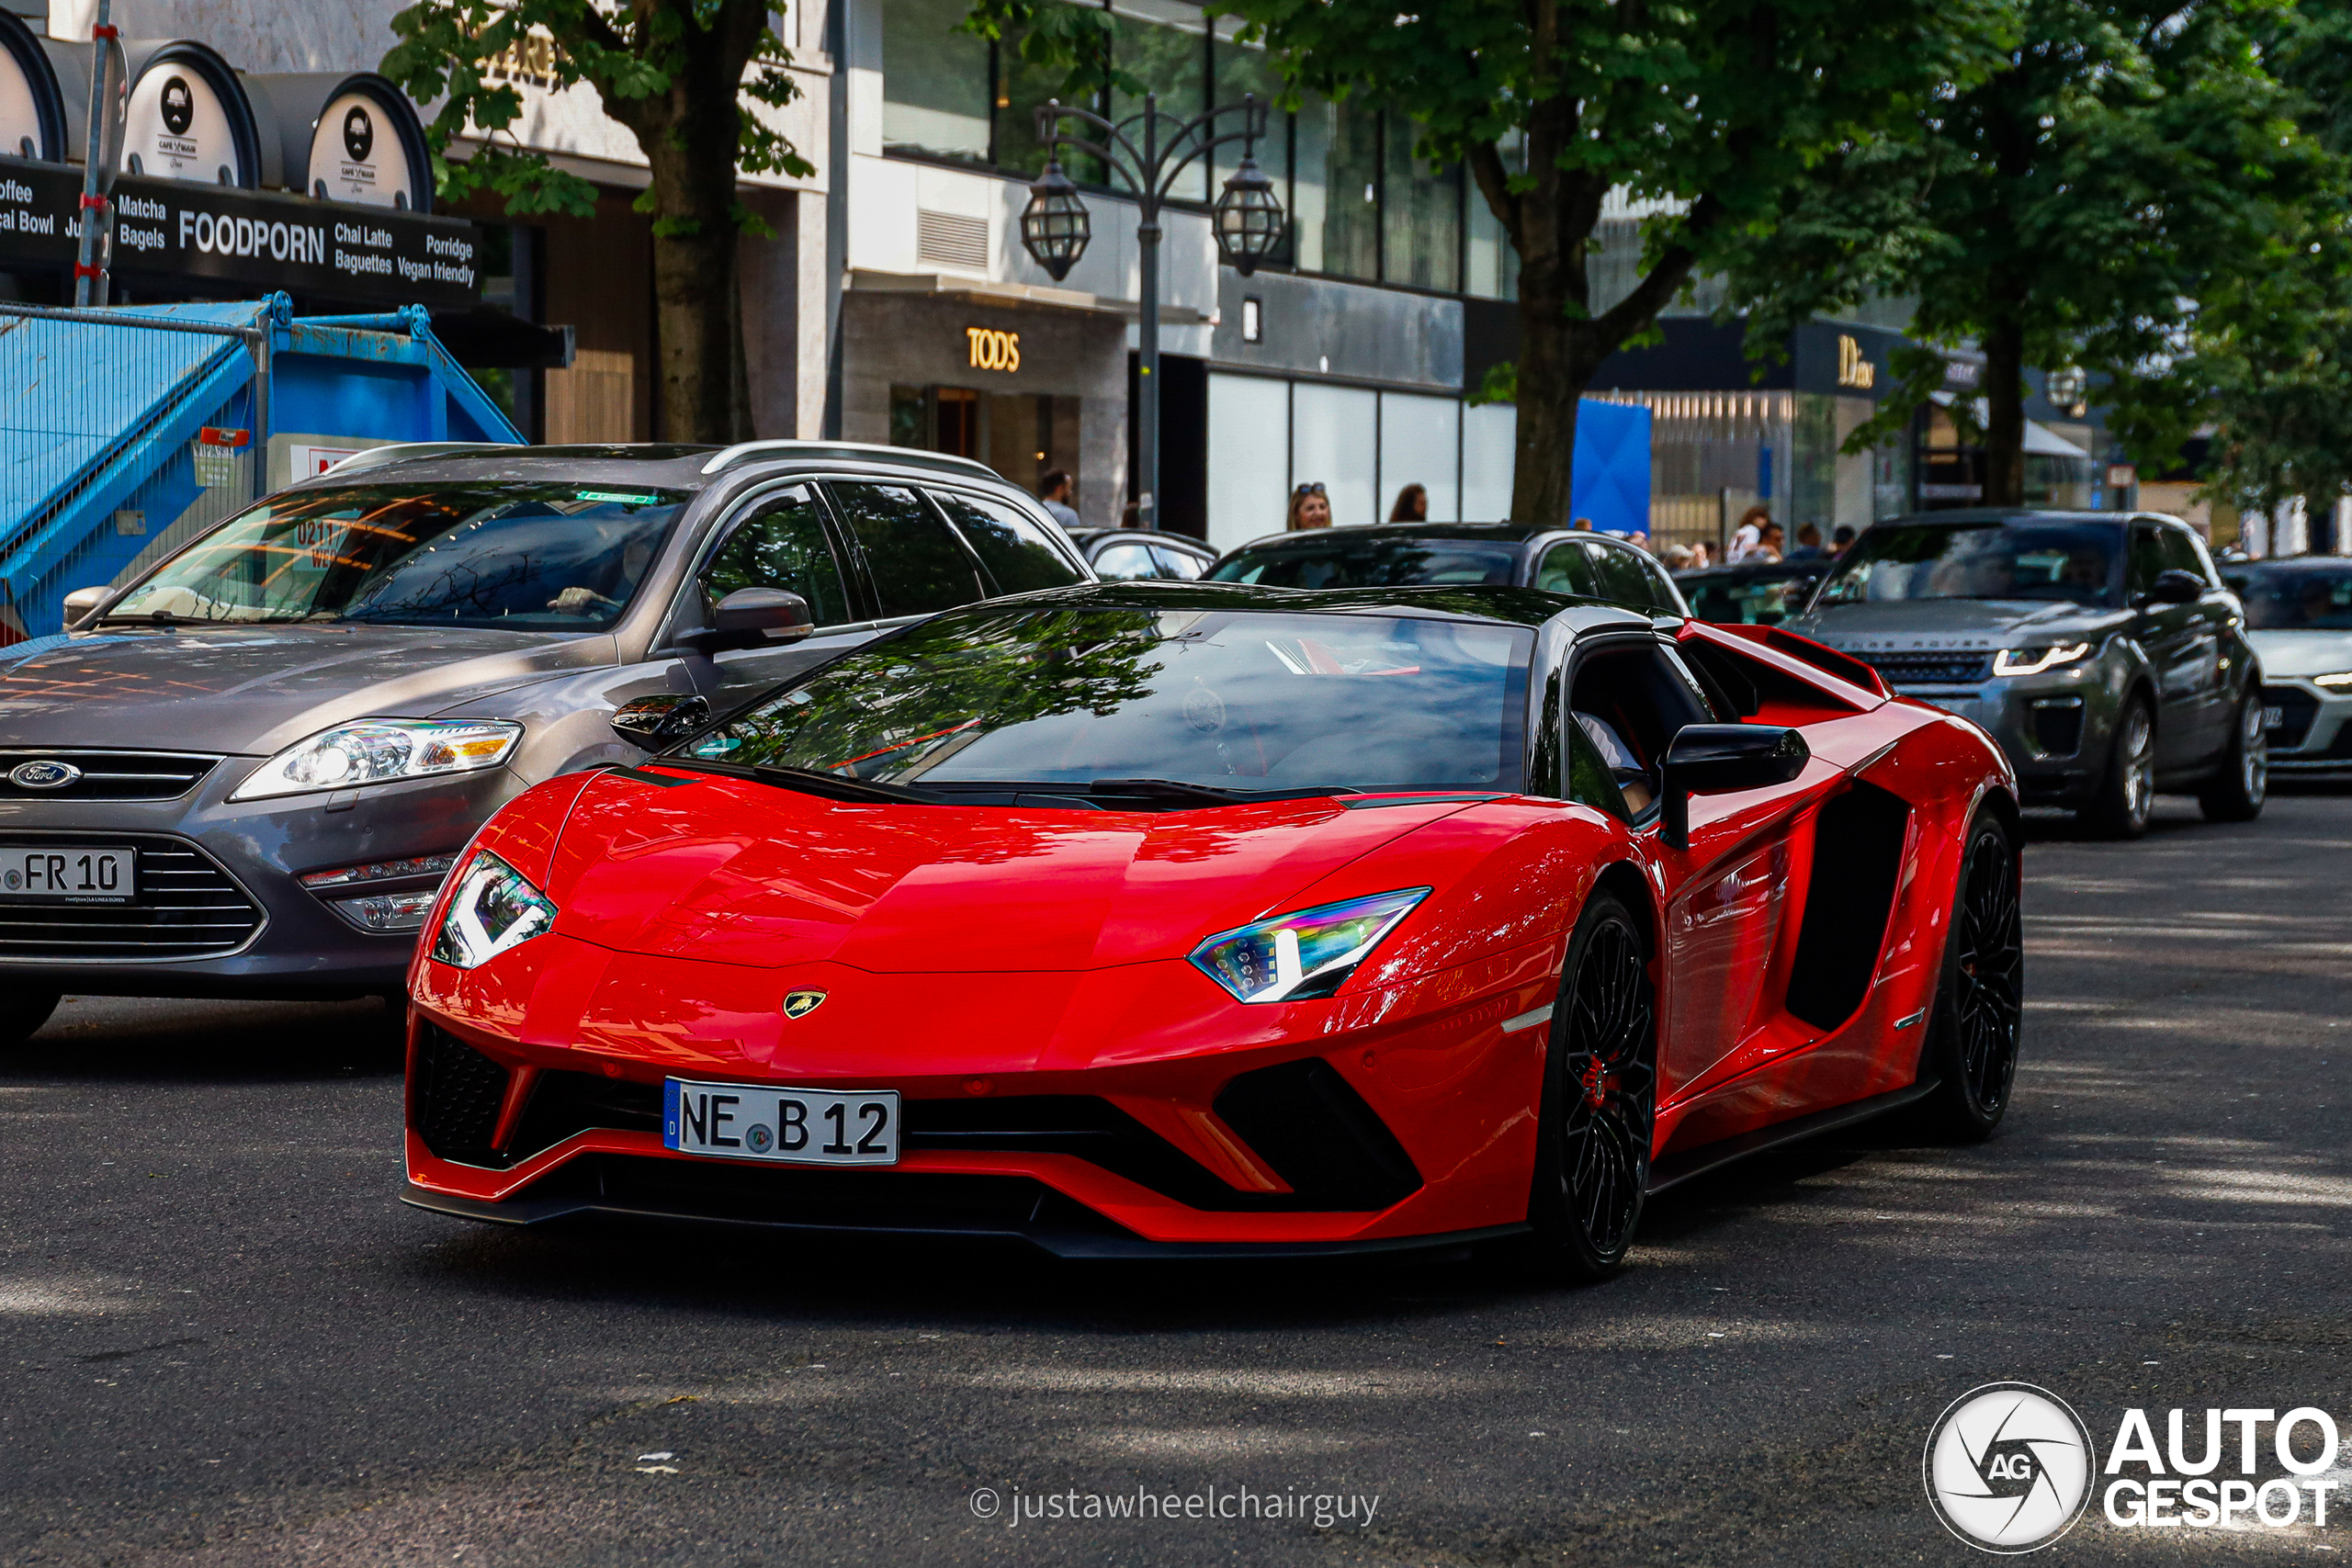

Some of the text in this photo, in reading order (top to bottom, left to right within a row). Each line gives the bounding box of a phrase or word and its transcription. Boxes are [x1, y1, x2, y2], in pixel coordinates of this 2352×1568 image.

[119, 194, 166, 220] Matcha
[19, 210, 54, 235] Bowl
[334, 222, 393, 249] Chai Latte
[119, 223, 165, 252] Bagels
[179, 209, 324, 265] FOODPORN
[426, 234, 473, 262] Porridge
[334, 249, 392, 276] Baguettes
[397, 256, 475, 288] Vegan friendly
[1912, 638, 1989, 649] ROVER
[25, 766, 57, 780] Ford
[25, 853, 119, 890] FR 10
[669, 1120, 676, 1135] D
[683, 1090, 888, 1154] NE B 12
